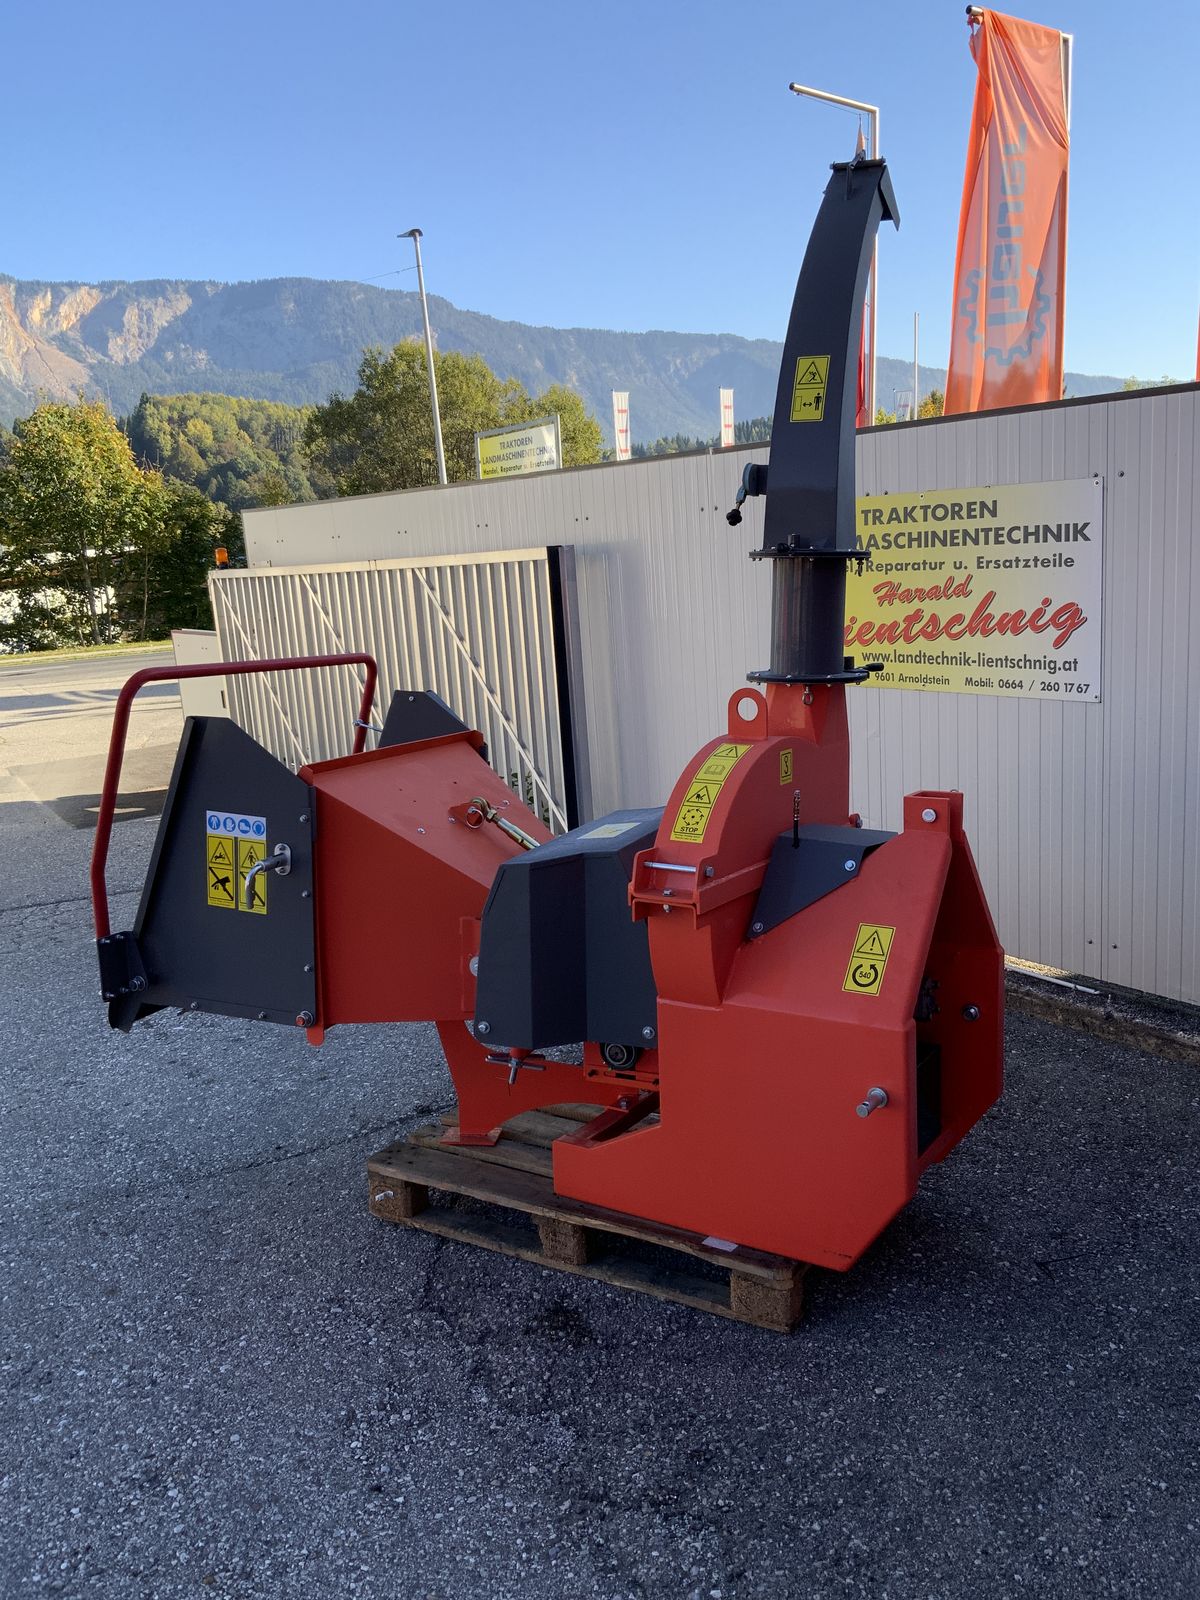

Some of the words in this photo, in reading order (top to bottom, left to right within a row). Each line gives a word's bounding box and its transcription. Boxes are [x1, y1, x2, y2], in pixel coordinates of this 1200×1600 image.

[499, 436, 533, 450] TRAKTOREN
[861, 500, 998, 526] TRAKTOREN
[865, 560, 945, 575] Reparatur
[953, 560, 968, 570] u.
[976, 552, 1075, 570] Ersatzteile
[873, 574, 973, 607] Harald
[844, 591, 1087, 650] ientschnig
[862, 649, 1078, 675] www.landtechnik-lientschnig.at
[875, 672, 895, 683] 9601
[898, 672, 950, 686] Arnoldstein
[964, 677, 994, 688] Mobil:
[998, 679, 1024, 690] 0664
[1040, 681, 1060, 692] 260
[859, 971, 872, 979] 540
